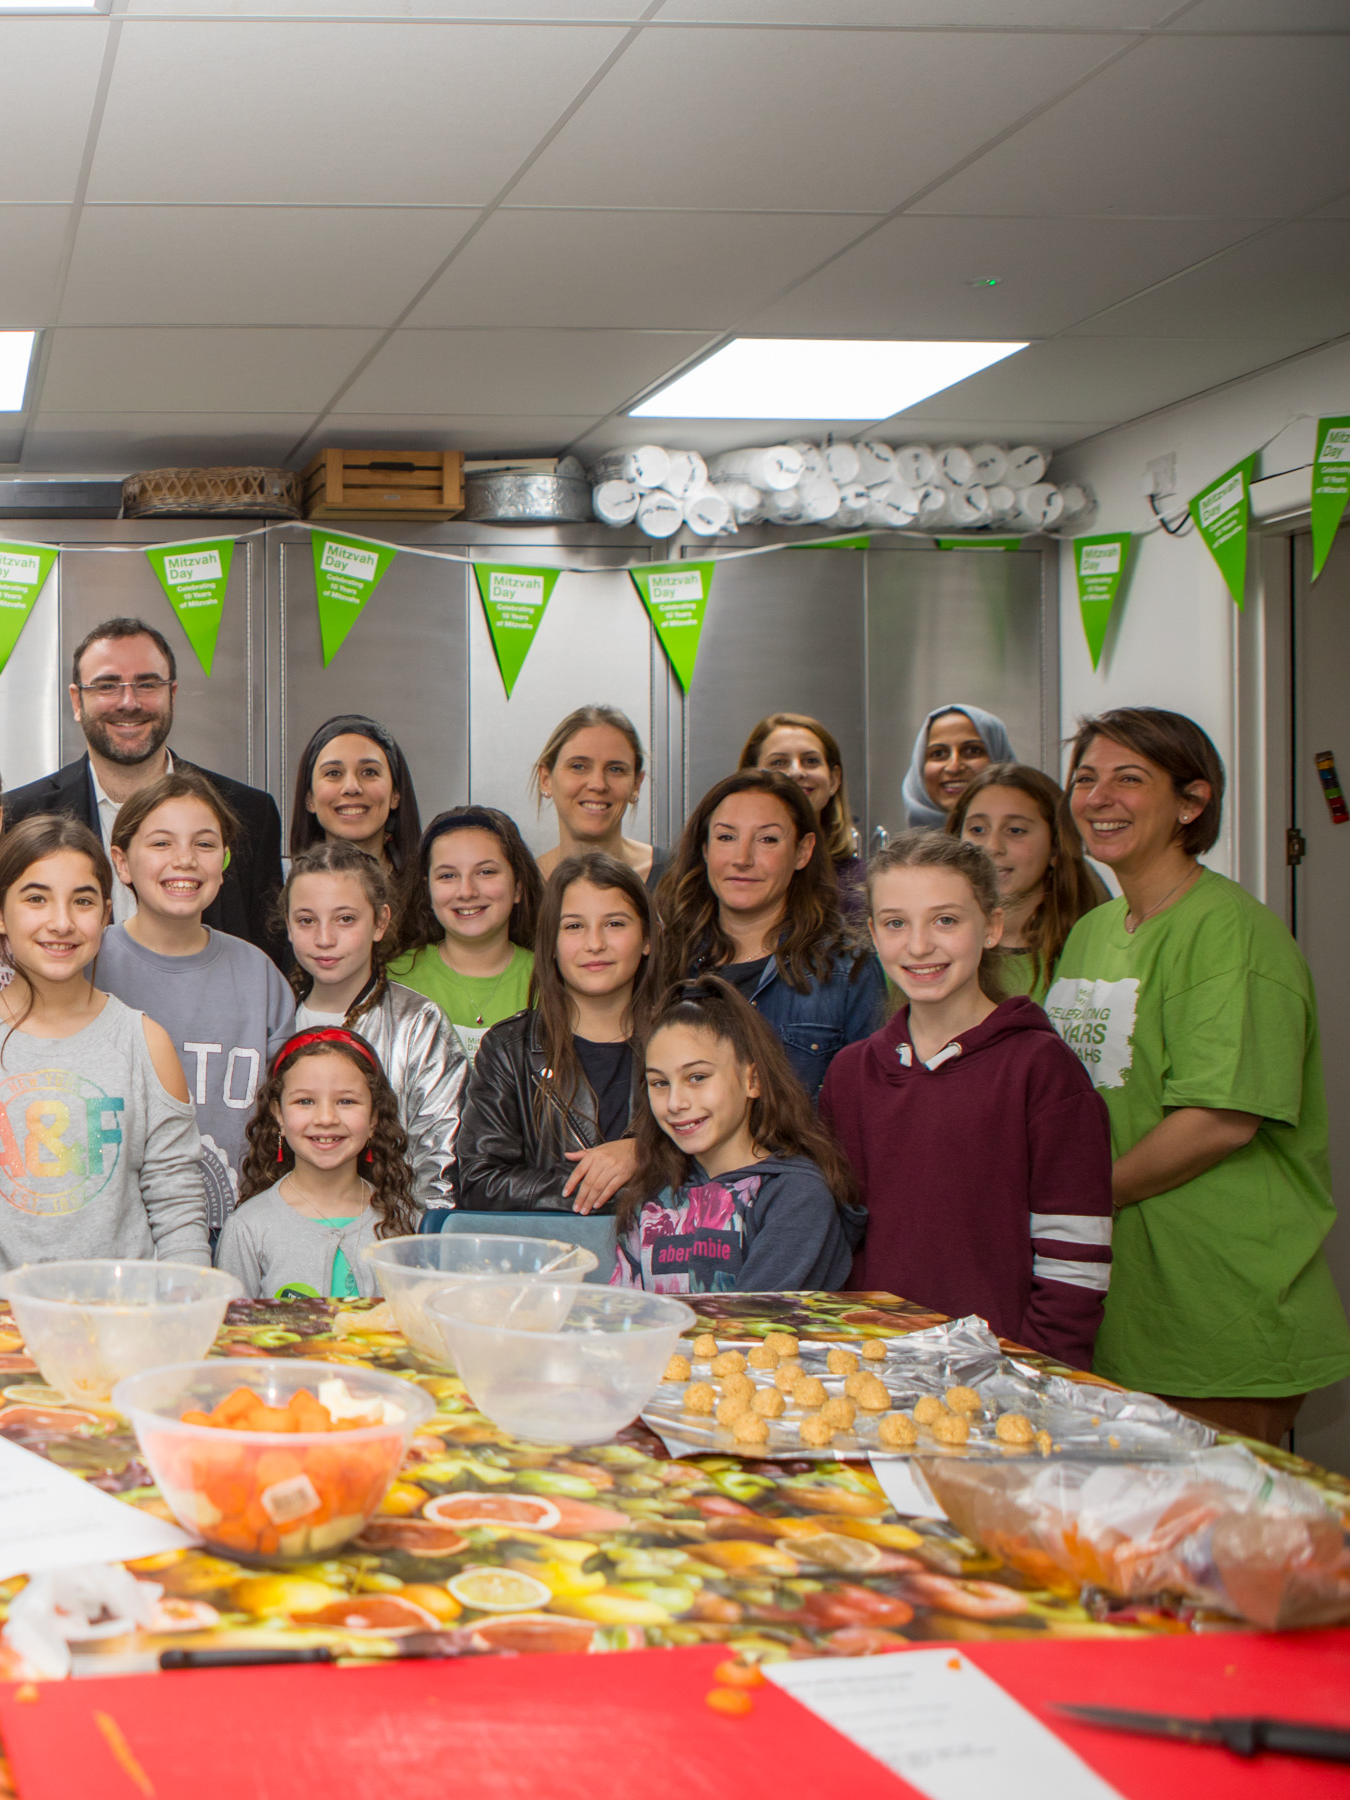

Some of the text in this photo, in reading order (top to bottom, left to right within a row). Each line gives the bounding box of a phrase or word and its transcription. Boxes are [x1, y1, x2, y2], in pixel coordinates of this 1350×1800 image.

[1322, 445, 1345, 459] Day
[168, 554, 217, 568] Mitzvah
[327, 545, 374, 565] Mitzvah
[325, 555, 348, 571] Day
[170, 569, 193, 580] Day
[652, 574, 698, 586] Mitzvah
[177, 583, 216, 592] Celebrating
[494, 576, 540, 589] Mitzvah
[493, 586, 516, 599] Day
[653, 588, 676, 598] Day
[188, 599, 218, 607] Mitzvahs
[7, 1077, 38, 1094] NEW
